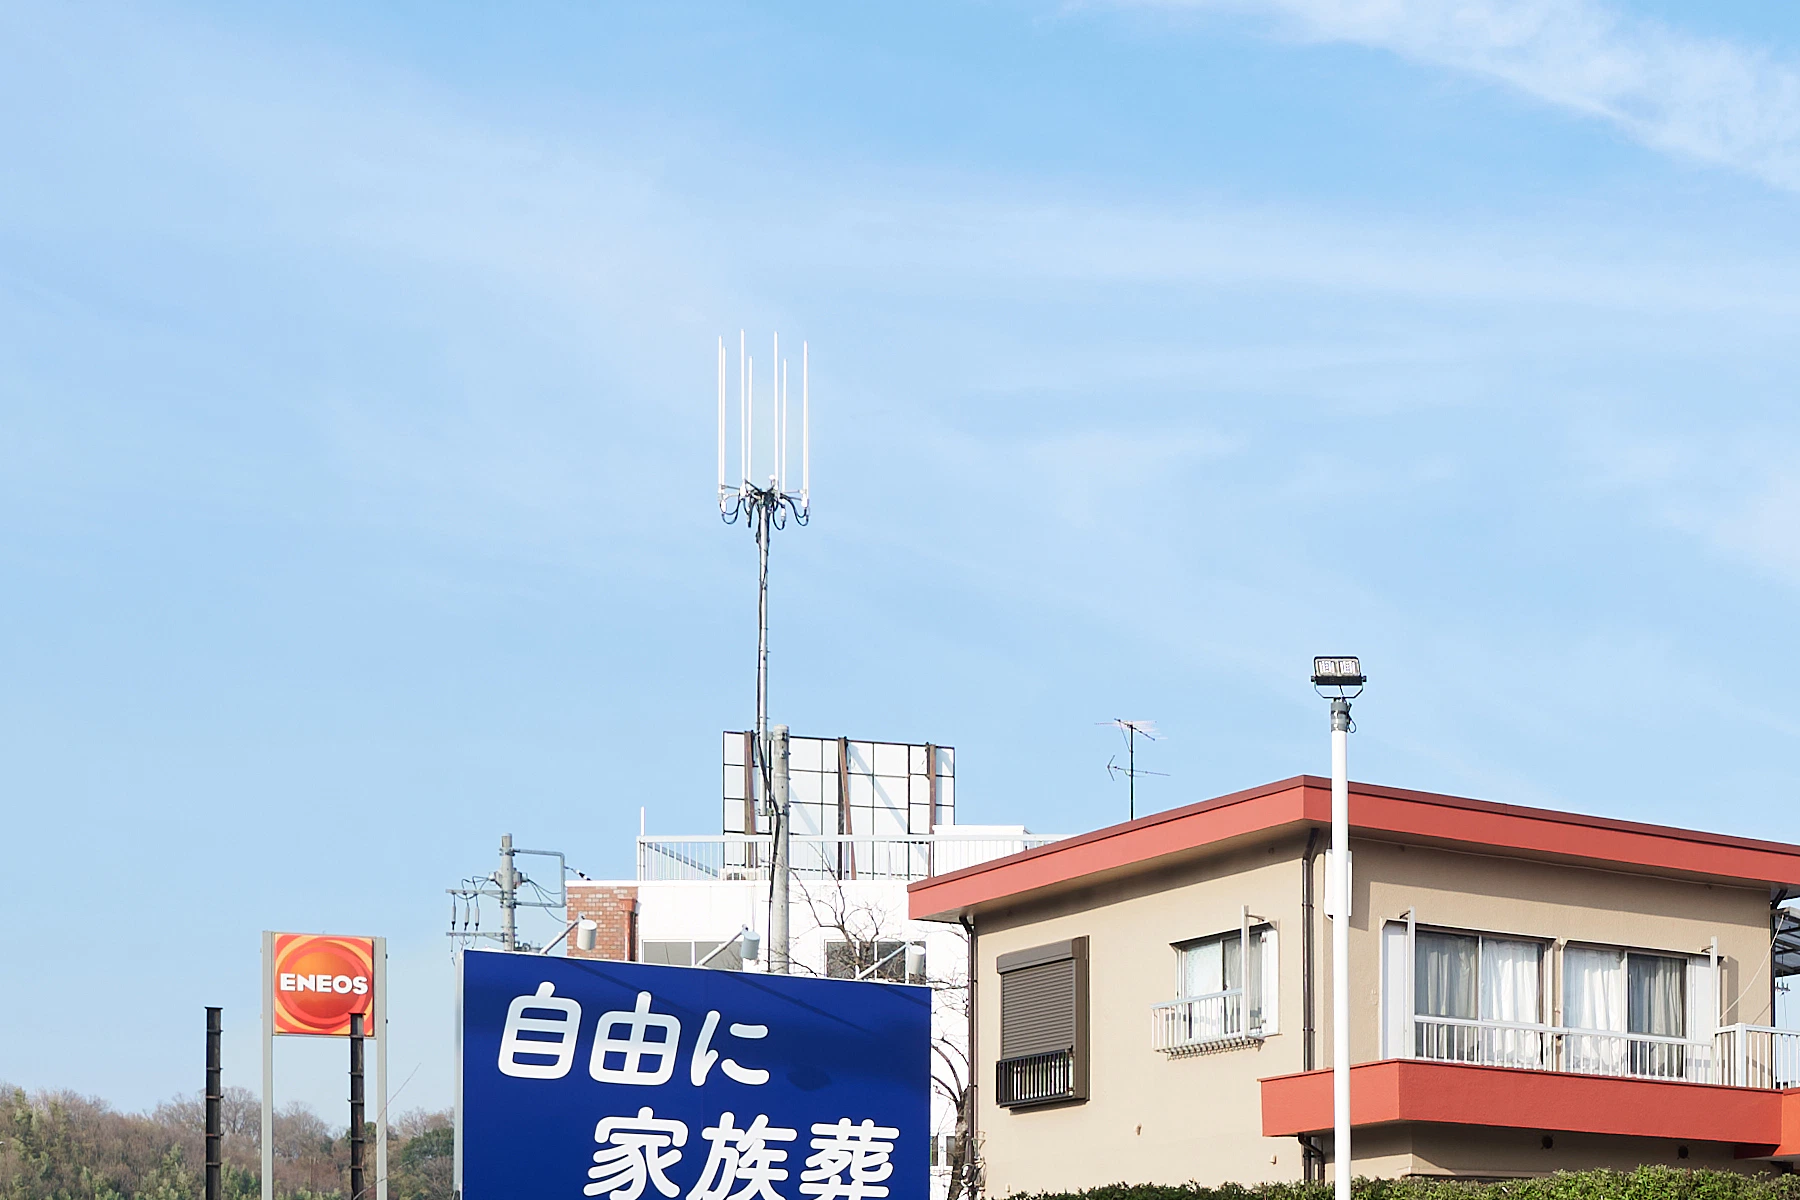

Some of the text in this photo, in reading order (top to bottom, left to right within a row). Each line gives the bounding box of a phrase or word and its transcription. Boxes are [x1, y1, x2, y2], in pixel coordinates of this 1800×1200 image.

[280, 973, 368, 995] ENEOS
[498, 981, 770, 1086] 自由に
